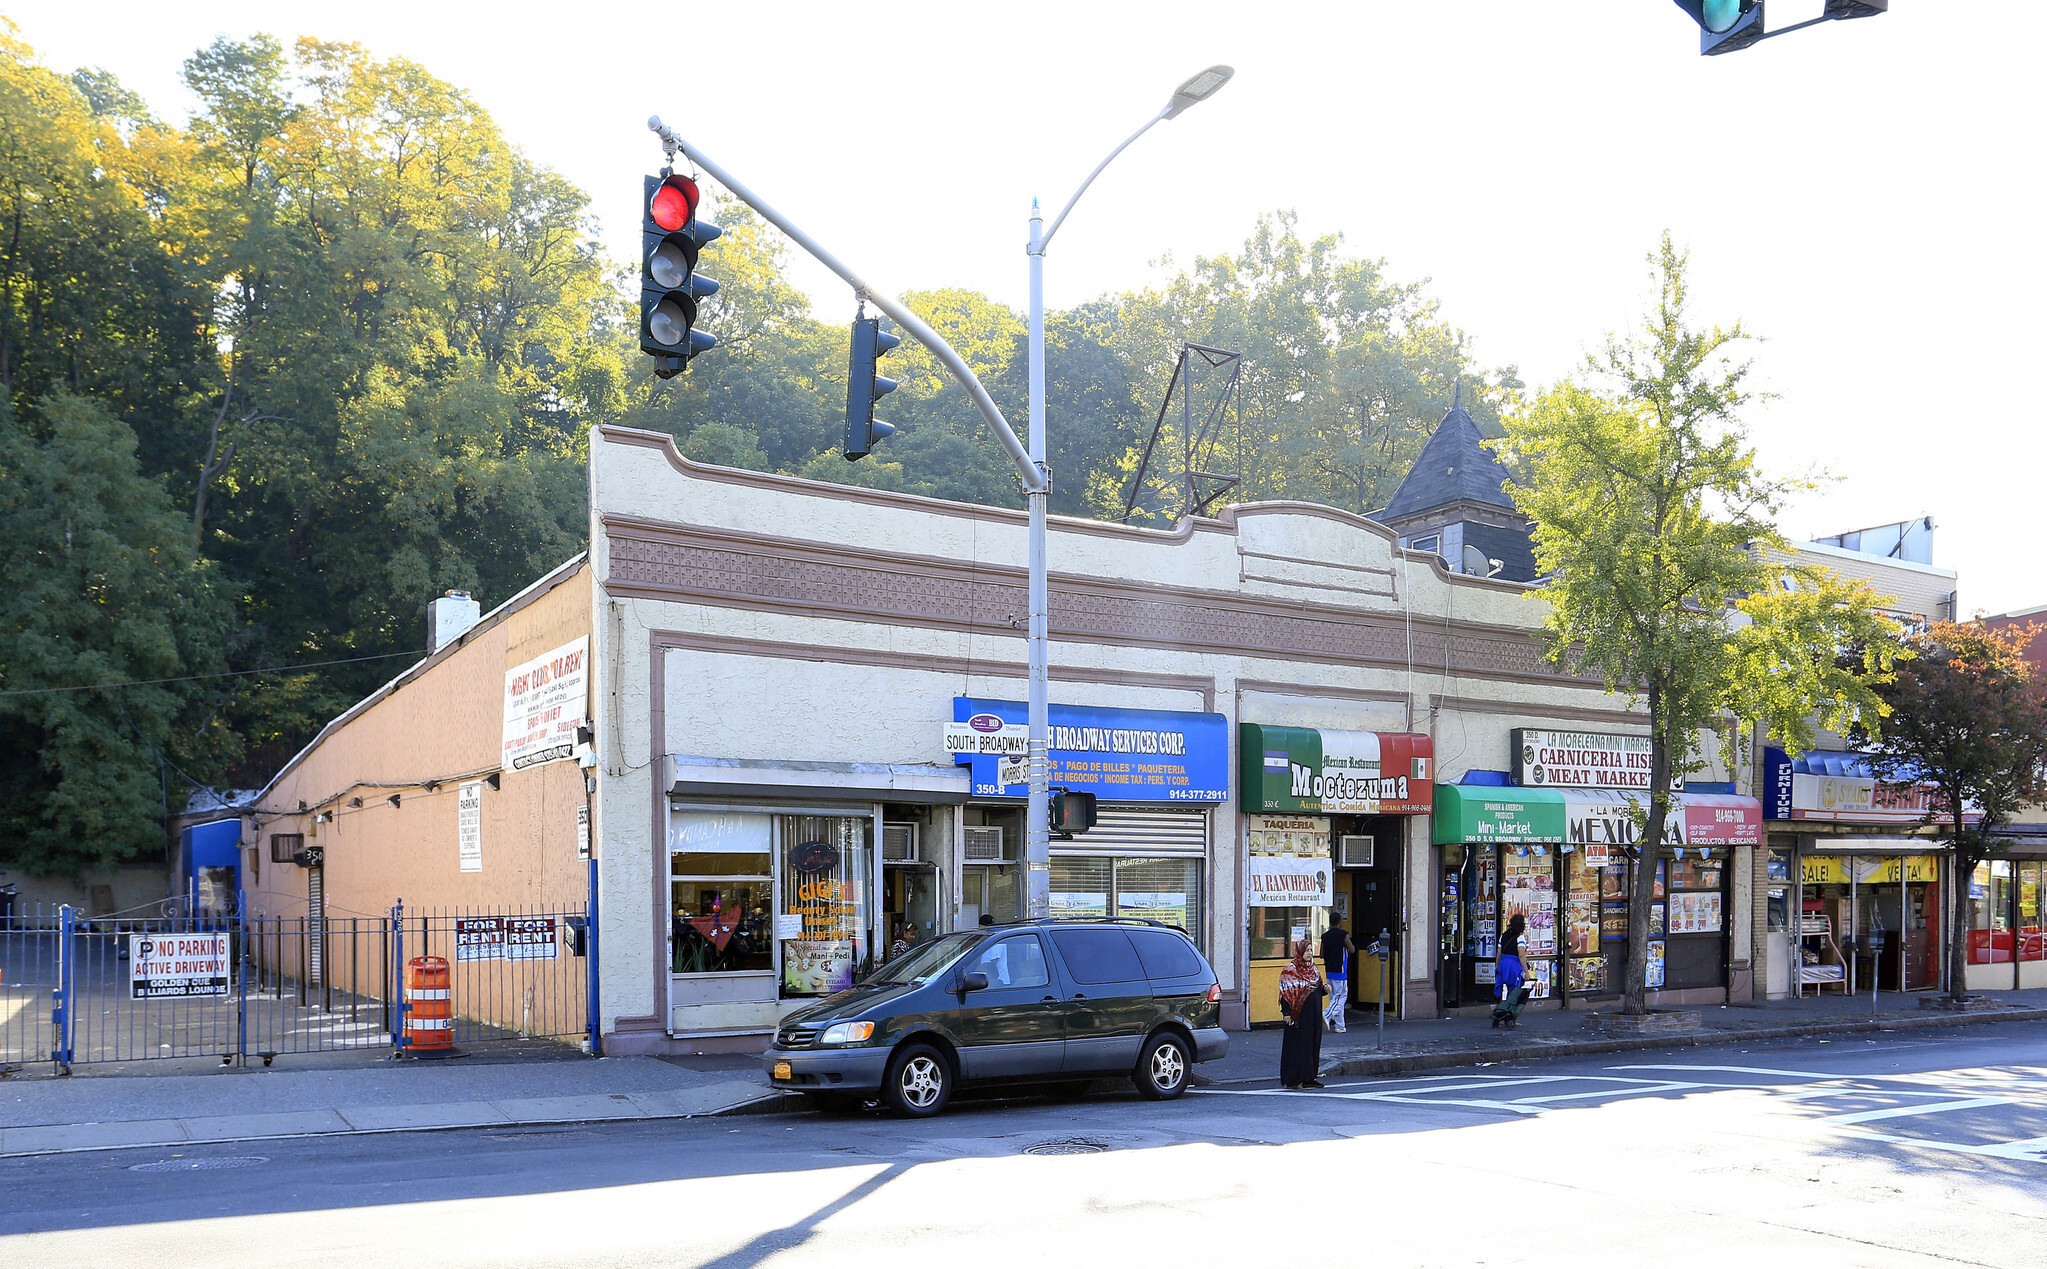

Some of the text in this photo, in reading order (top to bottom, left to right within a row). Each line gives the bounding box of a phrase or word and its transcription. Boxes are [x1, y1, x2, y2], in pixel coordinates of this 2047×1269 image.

[946, 734, 1026, 752] SOUTH BROADWAY
[1055, 726, 1112, 753] BROADWAY
[1112, 728, 1158, 755] SERVICES
[1159, 731, 1187, 757] CORP.
[1547, 732, 1557, 747] LA
[1558, 733, 1605, 750] MORELEANA
[1605, 736, 1623, 751] MINI
[1322, 755, 1381, 770] Mexican Restaurant
[1540, 748, 1623, 768] CARNICERIA
[1001, 765, 1021, 782] MORRIS
[1066, 761, 1089, 772] PAGO
[1090, 761, 1102, 772] DE
[1102, 762, 1130, 773] BILLES
[1137, 763, 1186, 775] PAQUETERIA
[1054, 772, 1063, 782] DE
[1064, 772, 1099, 783] NEGOCIOS
[1104, 774, 1130, 784] INCOME
[1147, 775, 1166, 785] PERS.
[1166, 776, 1172, 785] Y
[1172, 776, 1190, 786] CORP.
[1291, 761, 1409, 800] Moctezuma
[1547, 768, 1591, 785] MEAT
[976, 783, 1006, 795] 350-B
[1169, 789, 1227, 800] 914-377-2911
[1777, 763, 1791, 819] FURNITURE
[1596, 806, 1608, 816] LA
[1263, 819, 1315, 830] TAQUERIA
[1570, 817, 1685, 844] MEXICNA
[1690, 837, 1758, 845] PRODUCTOS MEXICANOS
[1586, 846, 1607, 857] ATM
[1802, 865, 1829, 882] SALE!
[1887, 865, 1922, 881] VETA!
[1252, 874, 1316, 893] EL RANCHERO
[1260, 892, 1320, 902] Mexican Restaurant
[789, 904, 857, 916] Beauty Salon
[458, 931, 503, 944] RENT
[508, 931, 554, 944] RENT
[159, 940, 175, 957] NO
[178, 938, 225, 957] PARKING
[810, 952, 829, 960] Mani
[834, 952, 850, 960] Pedi
[135, 959, 225, 976] ACTIVE DRIVEWAY
[150, 977, 211, 988] GOLDEN CUE
[137, 986, 187, 997] BLLIARDS
